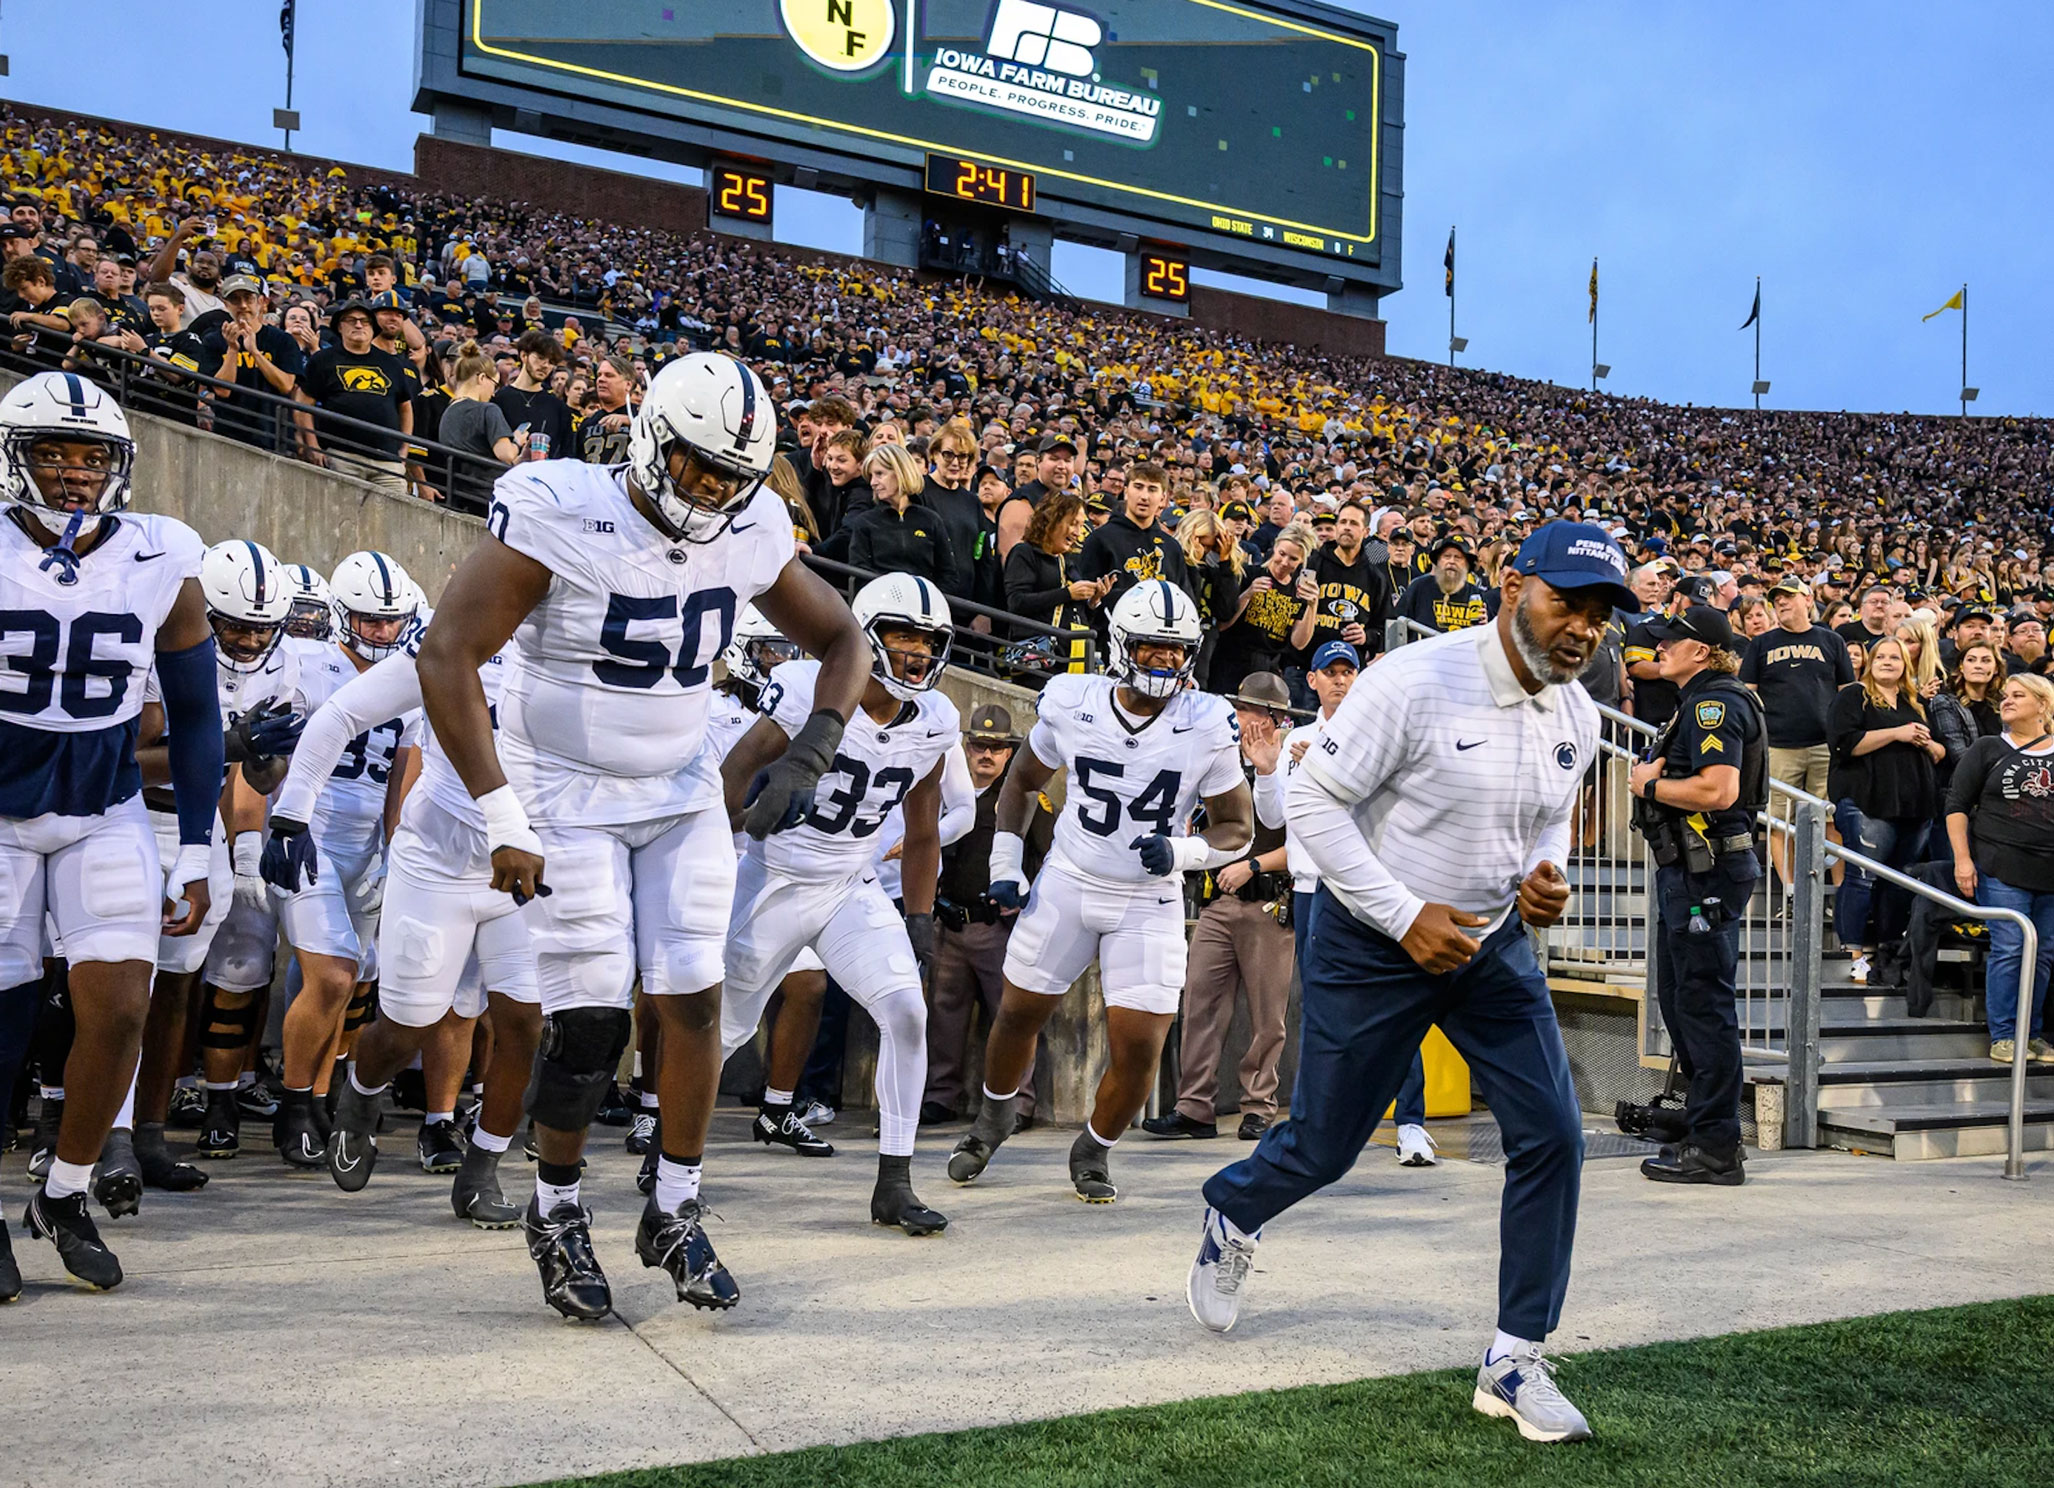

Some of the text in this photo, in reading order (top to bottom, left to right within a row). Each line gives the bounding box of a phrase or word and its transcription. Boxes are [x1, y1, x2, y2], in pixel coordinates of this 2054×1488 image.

[846, 31, 866, 57] F
[935, 48, 1161, 116] IOWA FARM BUREAU
[938, 76, 1002, 98] PEOPLE.
[1007, 92, 1090, 119] PROGRESS.
[720, 173, 767, 215] 25
[957, 161, 1030, 207] 2:41
[1212, 216, 1230, 231] OHIO
[1231, 219, 1253, 235] STATE
[1283, 231, 1324, 250] WISCONSIN
[1148, 258, 1186, 294] 25
[1567, 547, 1611, 561] NITTANY
[1576, 539, 1605, 551] PENN
[1319, 582, 1371, 612] IOWA
[592, 586, 737, 689] 50
[1767, 644, 1826, 665] IOWA
[0, 609, 143, 719] 36
[2021, 758, 2053, 768] CITY
[1075, 756, 1182, 838] 54
[759, 1113, 778, 1134] NIKE
